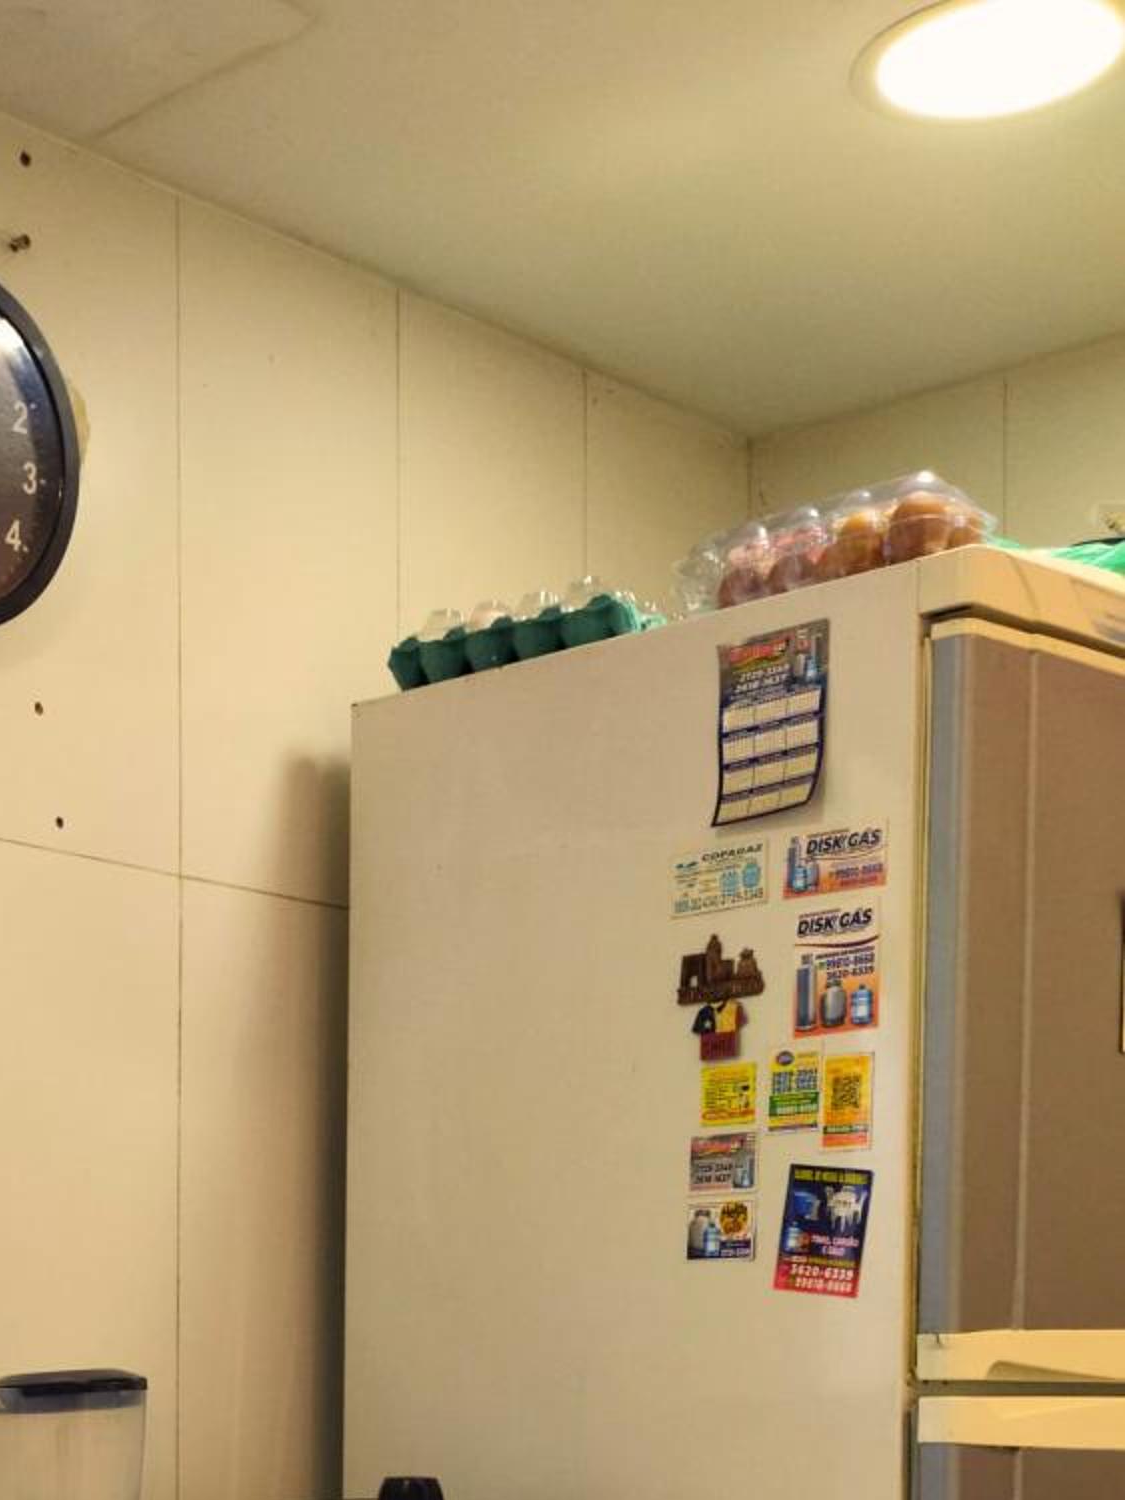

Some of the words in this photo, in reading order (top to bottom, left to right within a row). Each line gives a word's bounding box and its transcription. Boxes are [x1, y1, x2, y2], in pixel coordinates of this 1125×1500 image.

[13, 401, 28, 434] 2
[23, 462, 38, 495] 3
[5, 519, 22, 551] 4
[806, 834, 845, 855] DISK
[798, 915, 837, 937] DISK
